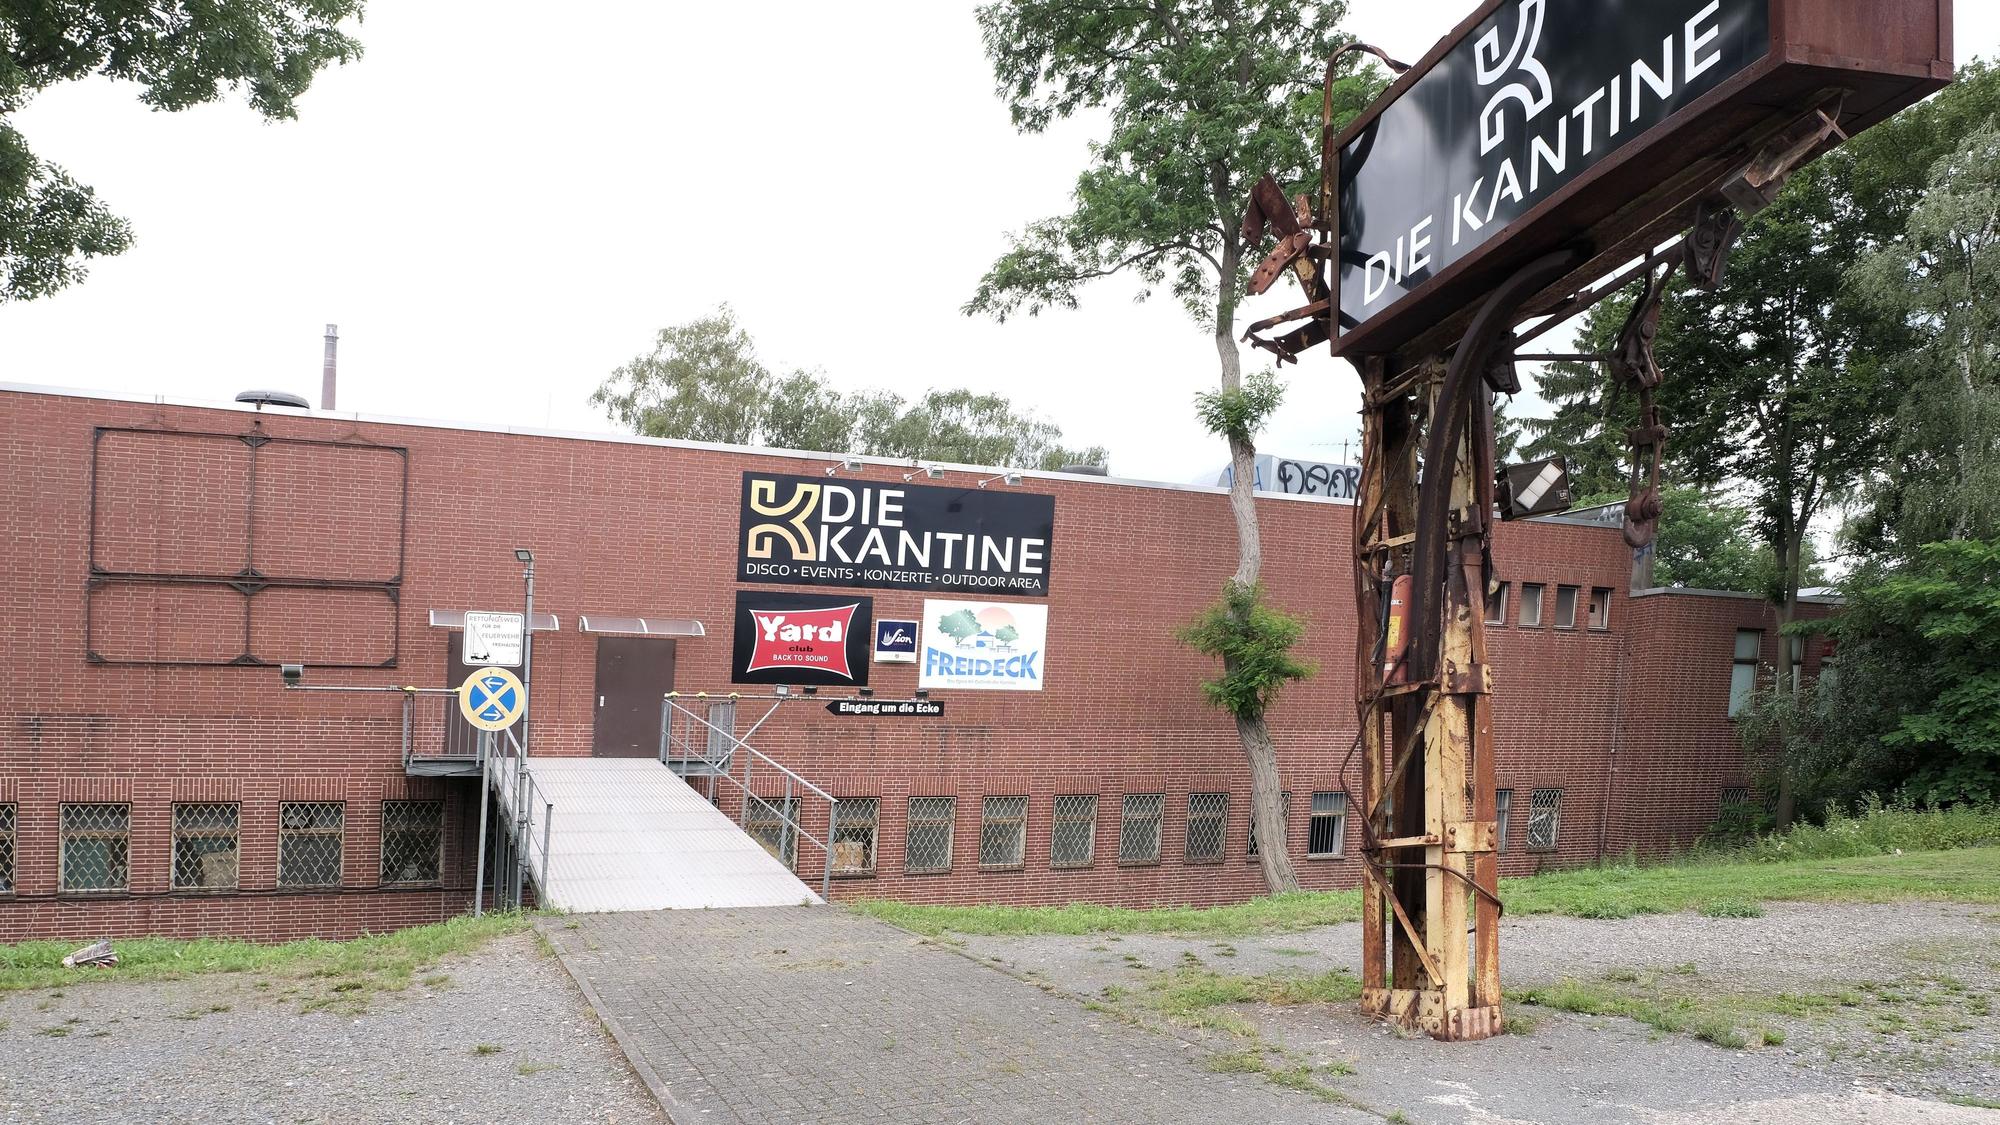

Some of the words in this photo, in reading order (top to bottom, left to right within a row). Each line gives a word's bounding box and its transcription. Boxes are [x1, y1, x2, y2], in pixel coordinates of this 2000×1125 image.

[1363, 214, 1434, 306] DIE
[1451, 0, 1721, 245] KANTINE
[821, 485, 905, 528] DIE
[818, 524, 1045, 575] KANTINE
[746, 562, 791, 576] DISCO
[800, 565, 855, 580] EVENTS
[863, 569, 933, 584] KONZERTE
[942, 573, 1006, 588] OUTDOOR
[1008, 577, 1042, 590] AREA
[468, 615, 520, 623] RETTUNGSWEG
[757, 615, 843, 642] Yard
[481, 632, 520, 640] FEUERWEHR
[881, 628, 913, 646] Sion
[788, 645, 814, 653] club
[794, 654, 803, 662] TO
[925, 646, 1039, 680] FREIDECK
[839, 702, 880, 714] Eingang
[881, 705, 897, 713] um
[898, 703, 914, 713] die
[916, 703, 940, 713] Ecke
